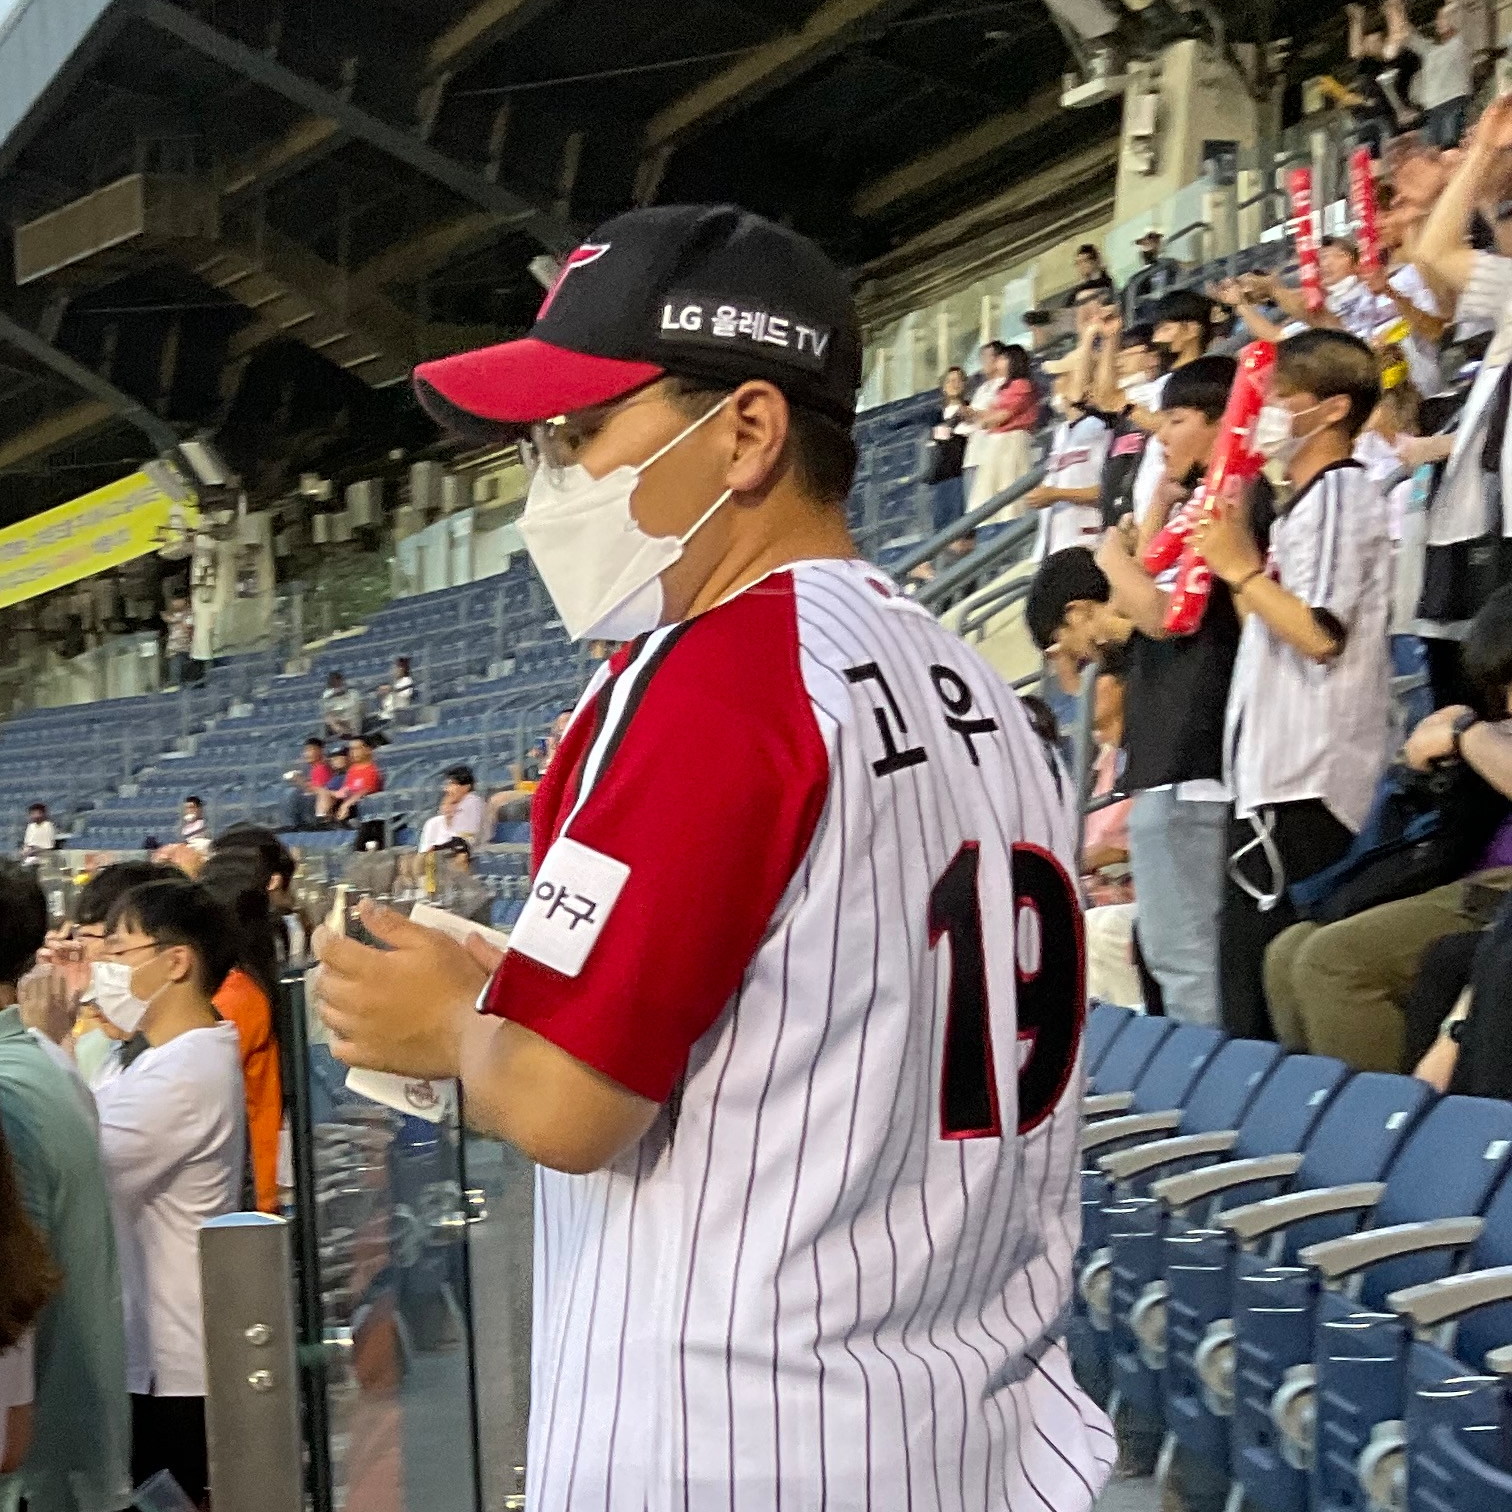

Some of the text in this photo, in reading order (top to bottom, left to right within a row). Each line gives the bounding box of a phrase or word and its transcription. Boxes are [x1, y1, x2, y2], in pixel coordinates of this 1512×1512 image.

[661, 304, 830, 358] LG 올레드 TV
[533, 879, 597, 931] 야구
[929, 839, 1087, 1141] 19
